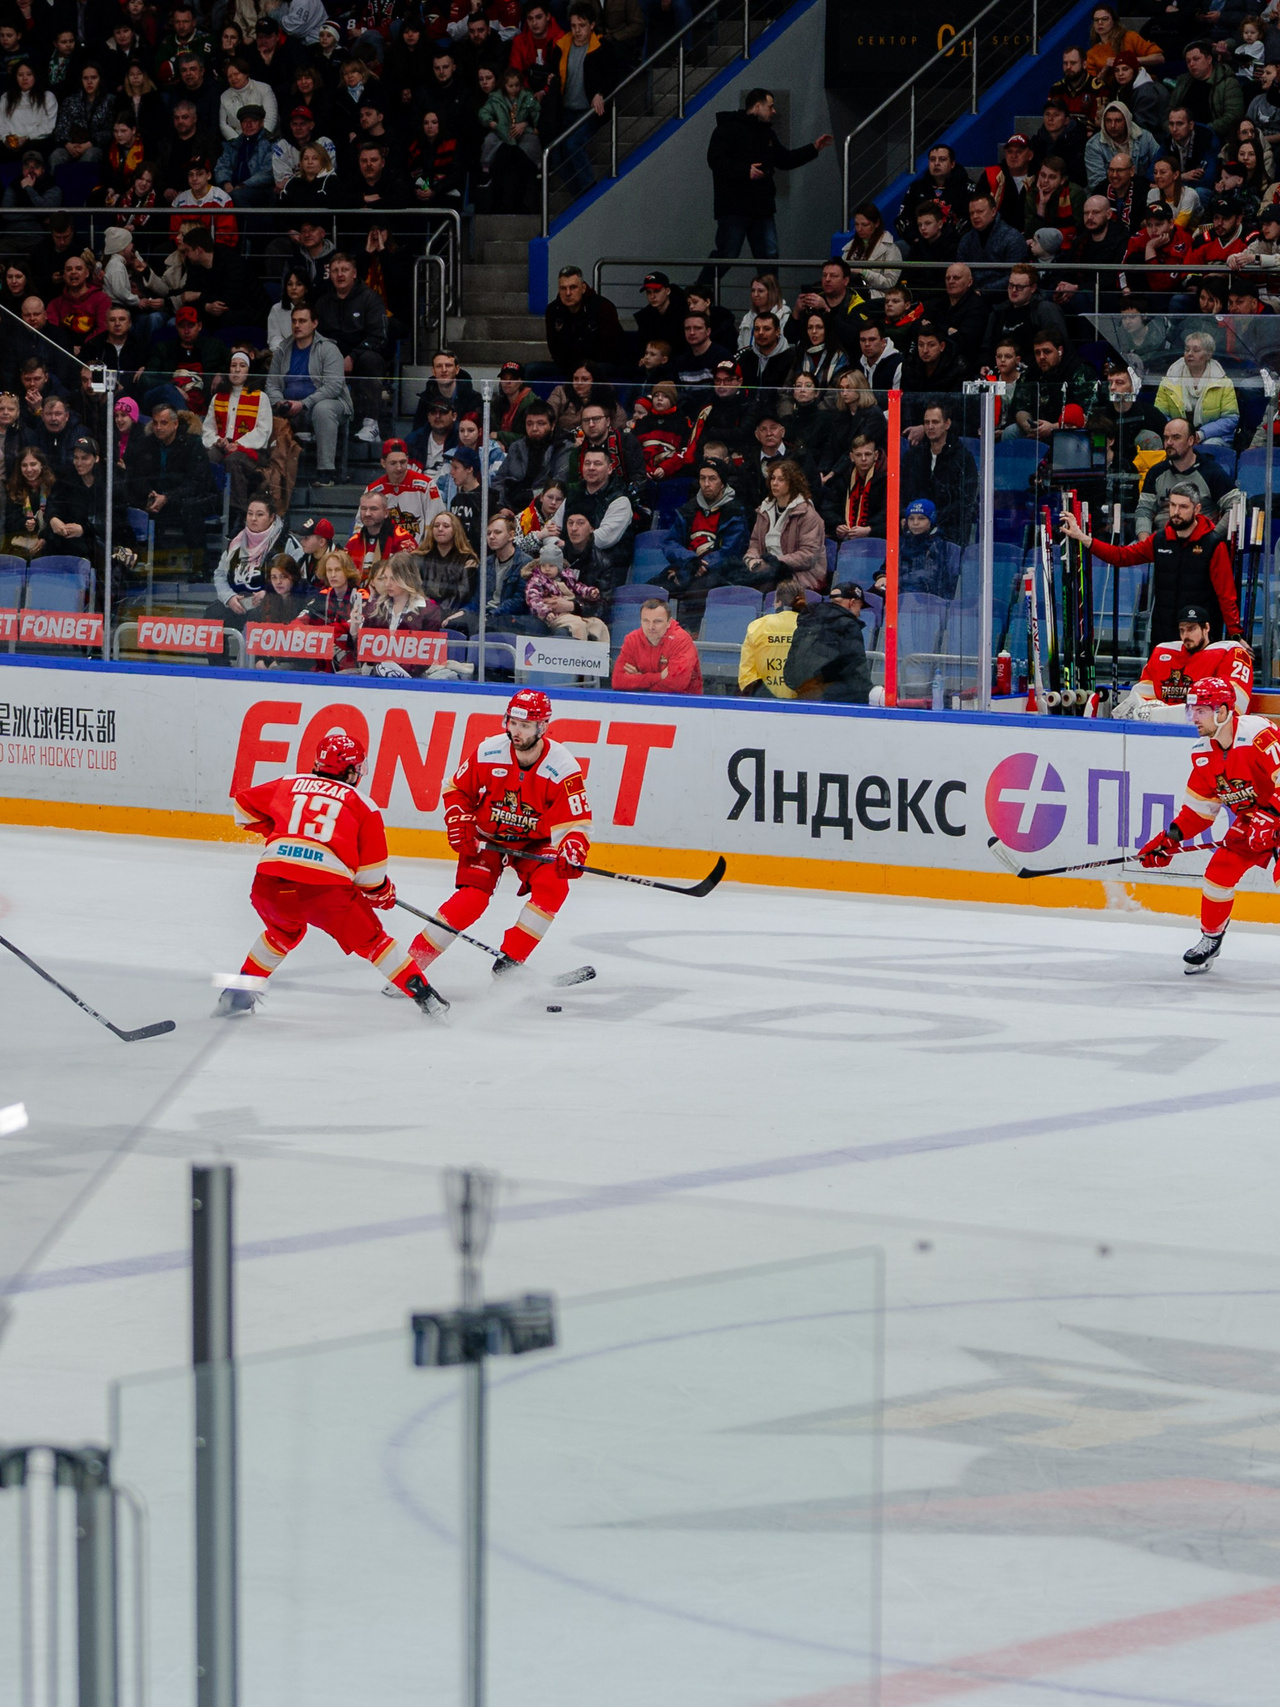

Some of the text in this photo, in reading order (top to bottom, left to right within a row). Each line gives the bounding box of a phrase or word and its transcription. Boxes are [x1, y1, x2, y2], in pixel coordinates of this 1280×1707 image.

[858, 36, 918, 45] СЕКТОР
[22, 615, 102, 641] FONBET
[139, 621, 221, 648] FONBET
[767, 635, 793, 643] SAFE
[248, 628, 331, 654] FONBET
[359, 634, 446, 661] FONBET
[537, 653, 602, 670] Ростелеком
[1230, 661, 1251, 684] 29
[8, 743, 36, 765] STAR
[40, 746, 84, 768] HOCKEY
[87, 749, 117, 770] CLUB
[291, 779, 350, 801] DUSZAK
[726, 747, 967, 841] Яндекс
[568, 794, 592, 816] 83
[287, 794, 343, 843] 13
[447, 814, 478, 824] CC
[489, 806, 540, 831] REDSTAR
[277, 844, 324, 862] SIBUR
[614, 873, 655, 888] CCM
